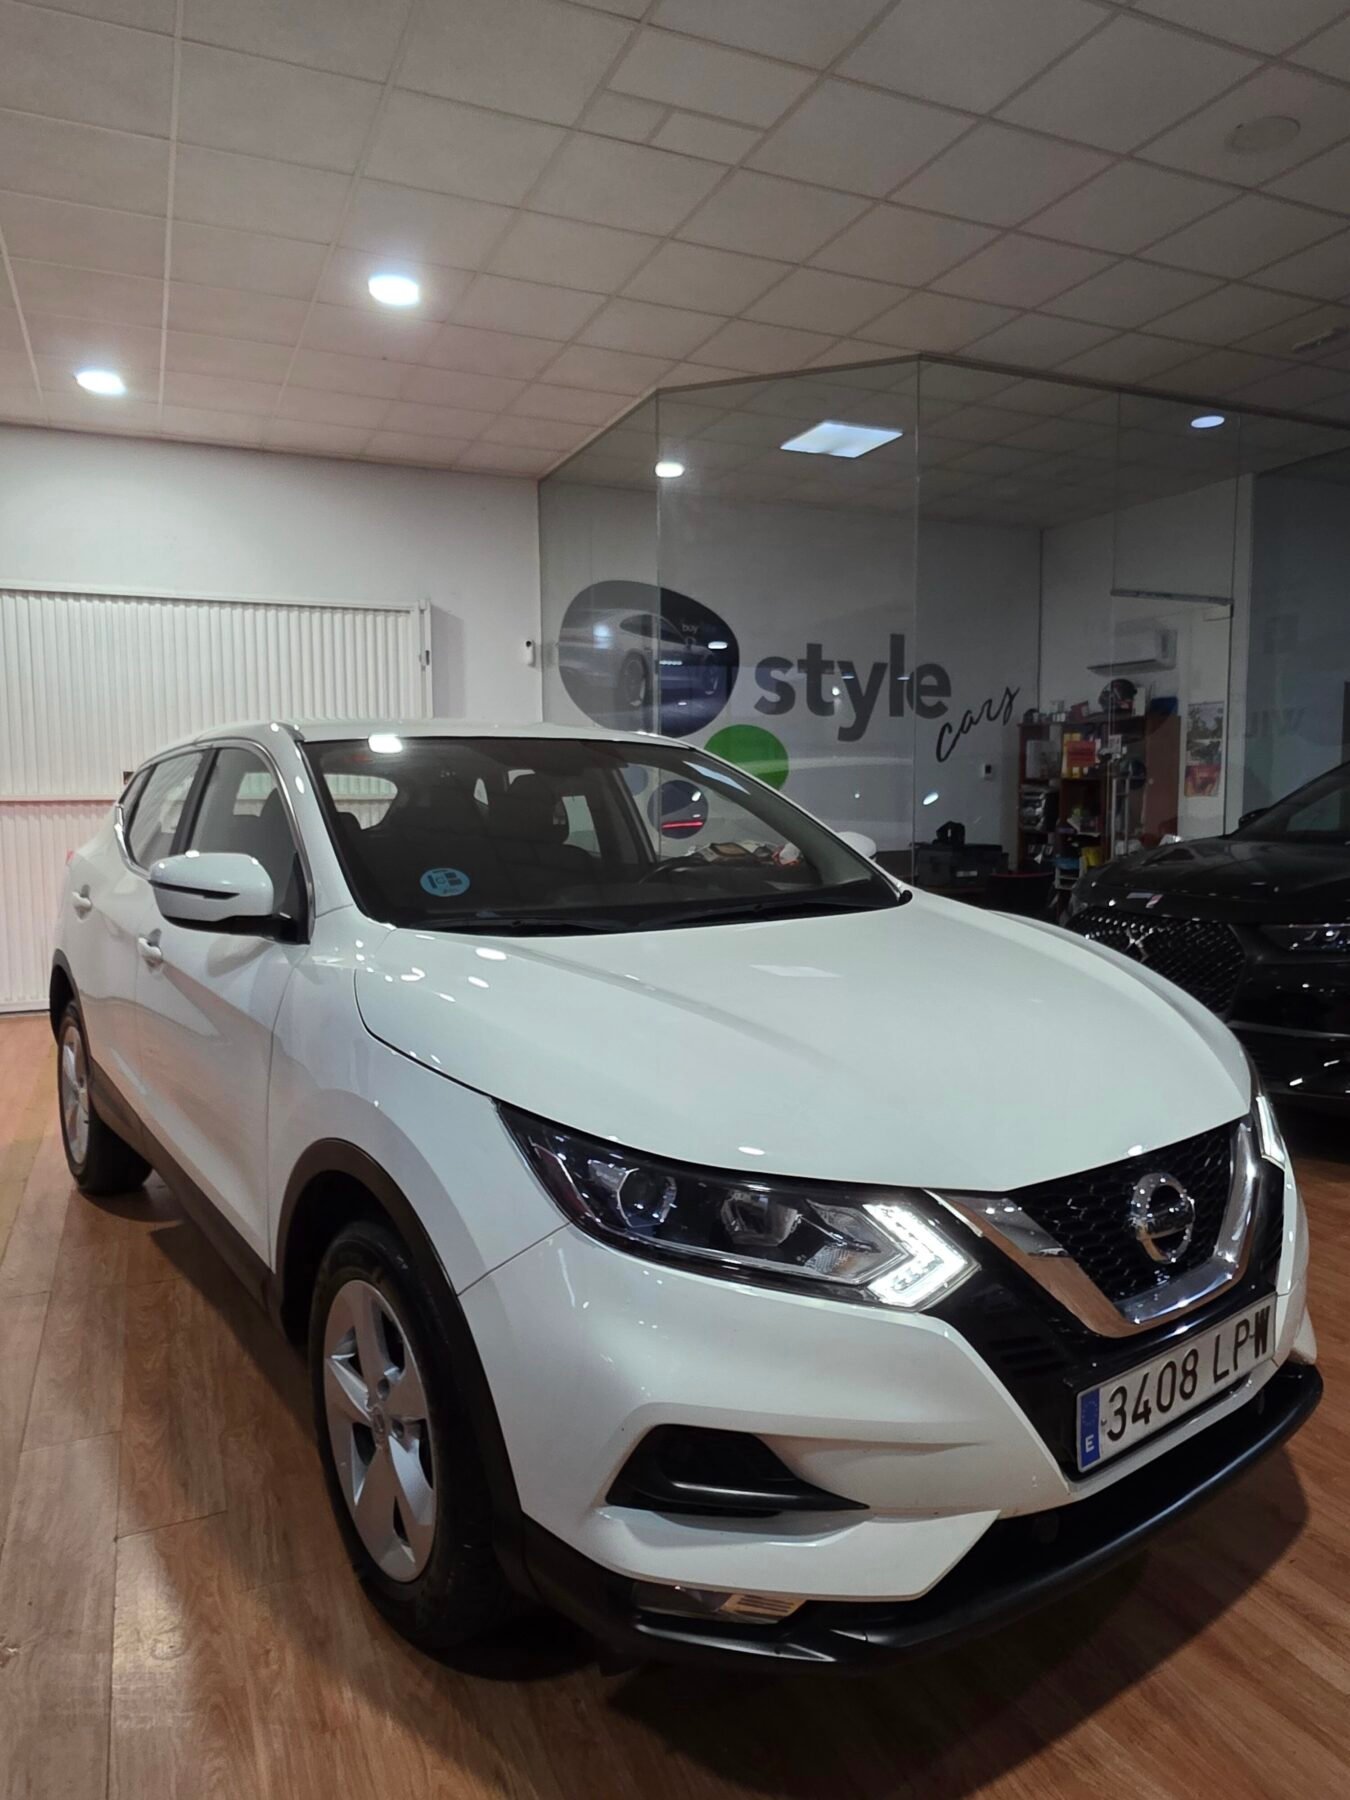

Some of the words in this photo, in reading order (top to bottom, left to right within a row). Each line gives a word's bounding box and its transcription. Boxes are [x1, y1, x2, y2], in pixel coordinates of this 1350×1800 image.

[754, 634, 951, 741] style
[1107, 1348, 1199, 1441] 3408
[1213, 1305, 1271, 1384] LPW
[1085, 1434, 1095, 1453] E
